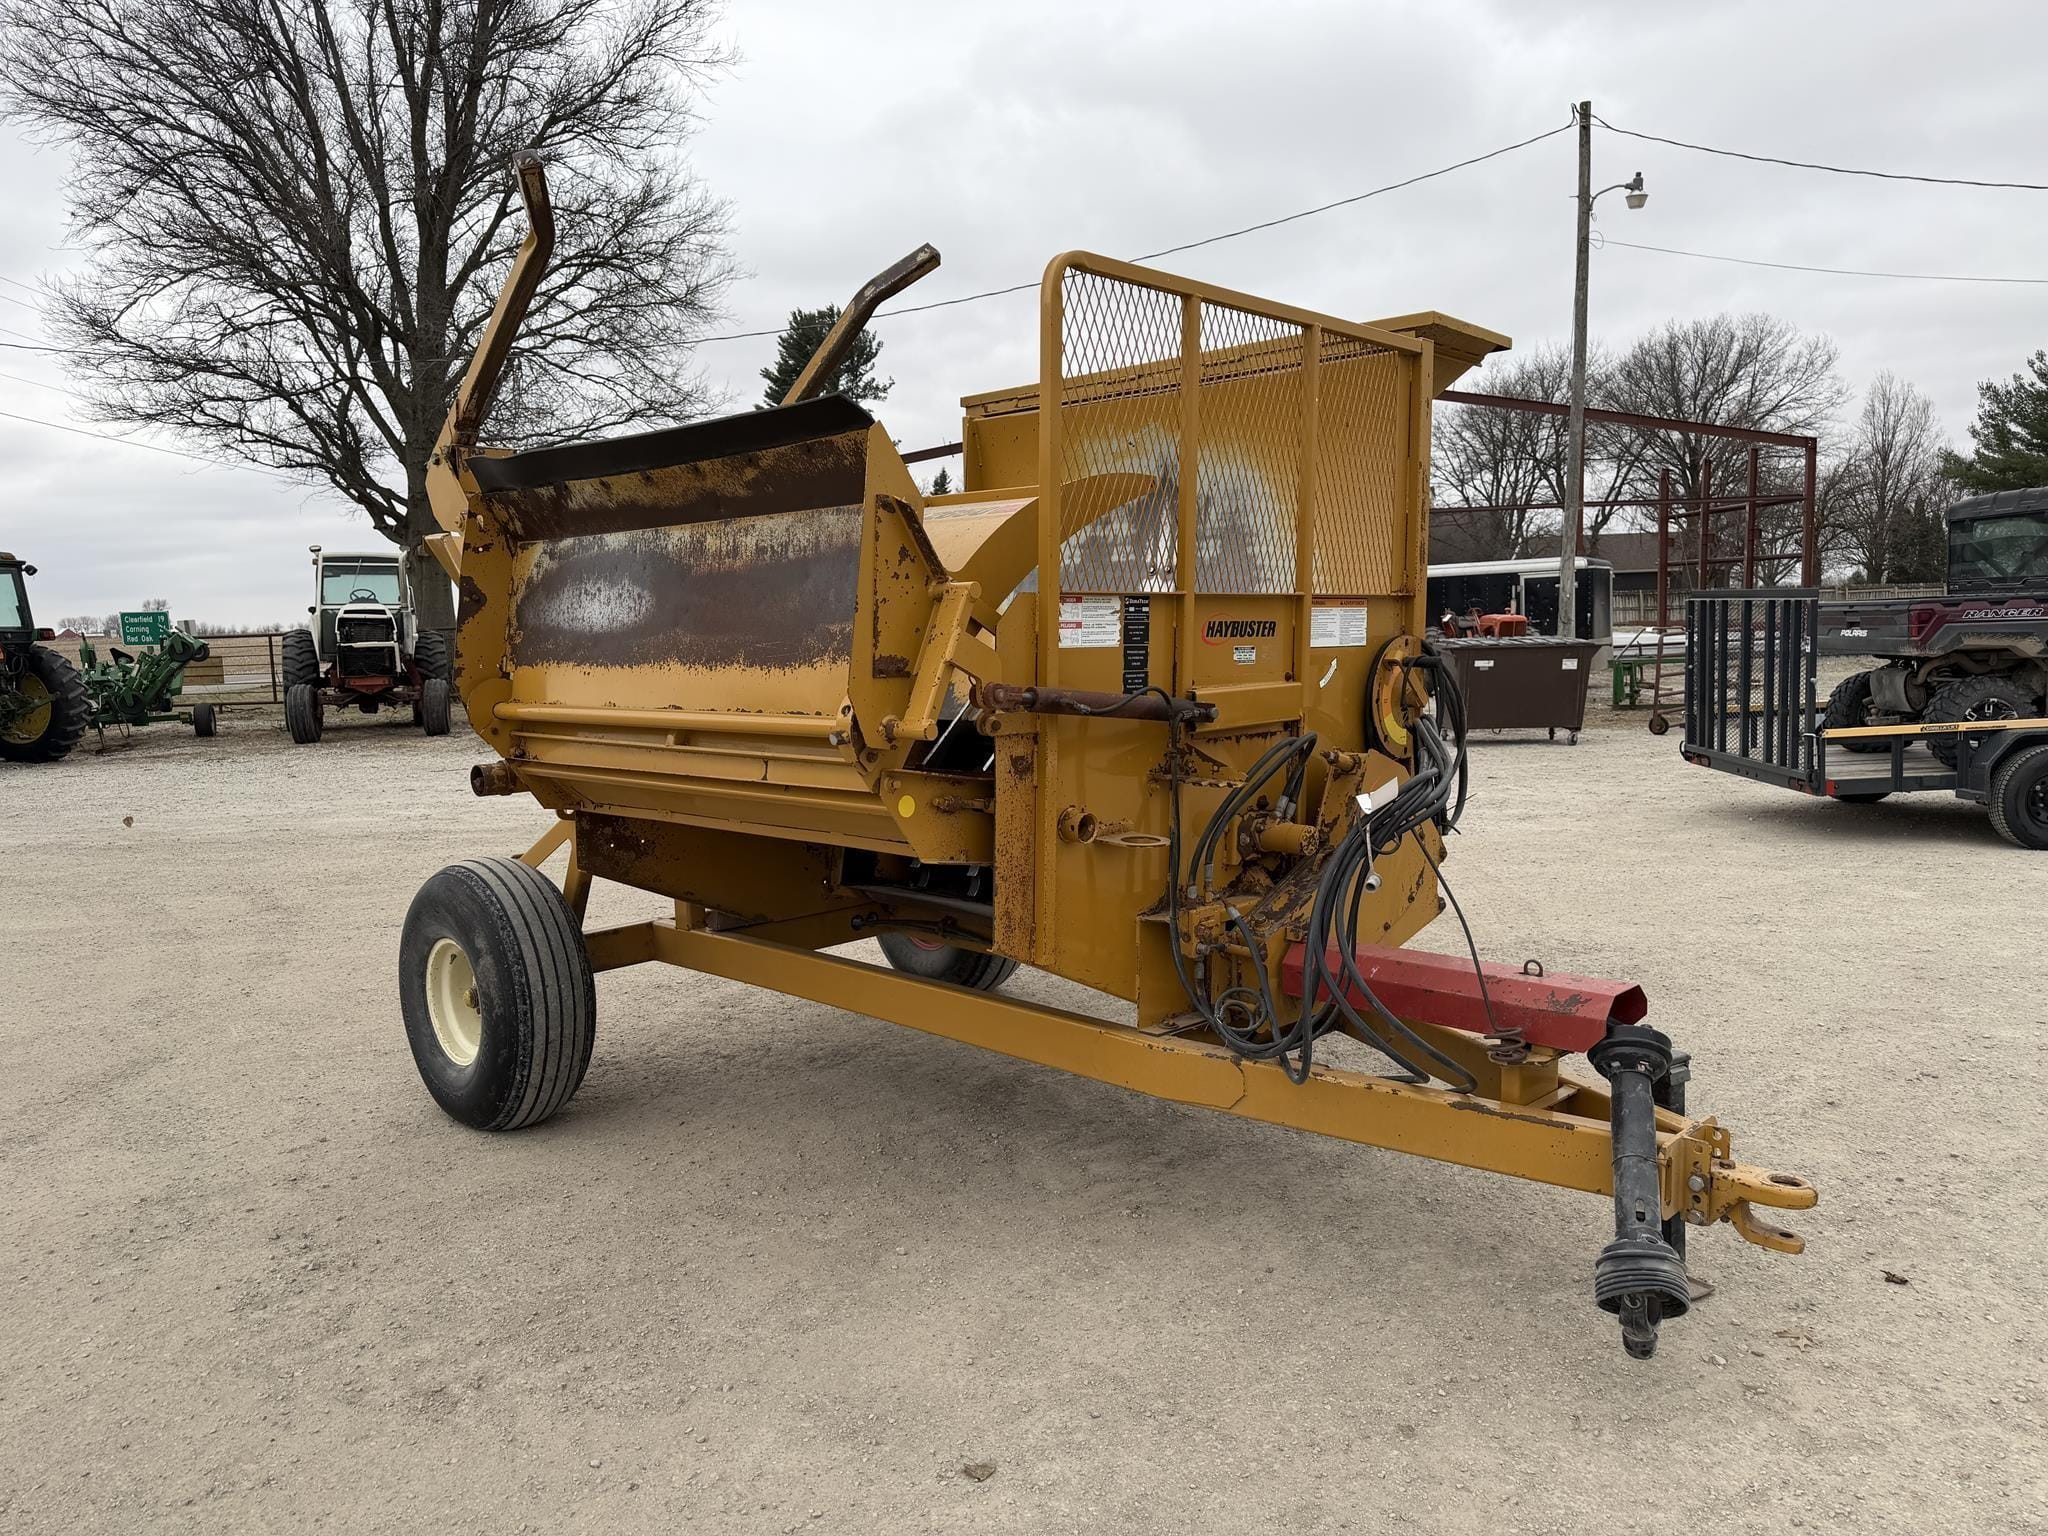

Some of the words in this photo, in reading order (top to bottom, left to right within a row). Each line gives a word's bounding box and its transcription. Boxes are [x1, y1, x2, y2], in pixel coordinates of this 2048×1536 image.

[1961, 608, 2045, 619] RANGER
[125, 625, 150, 634] Corning
[1206, 620, 1277, 638] HAYBUSTER
[1840, 629, 1868, 637] POLARIS
